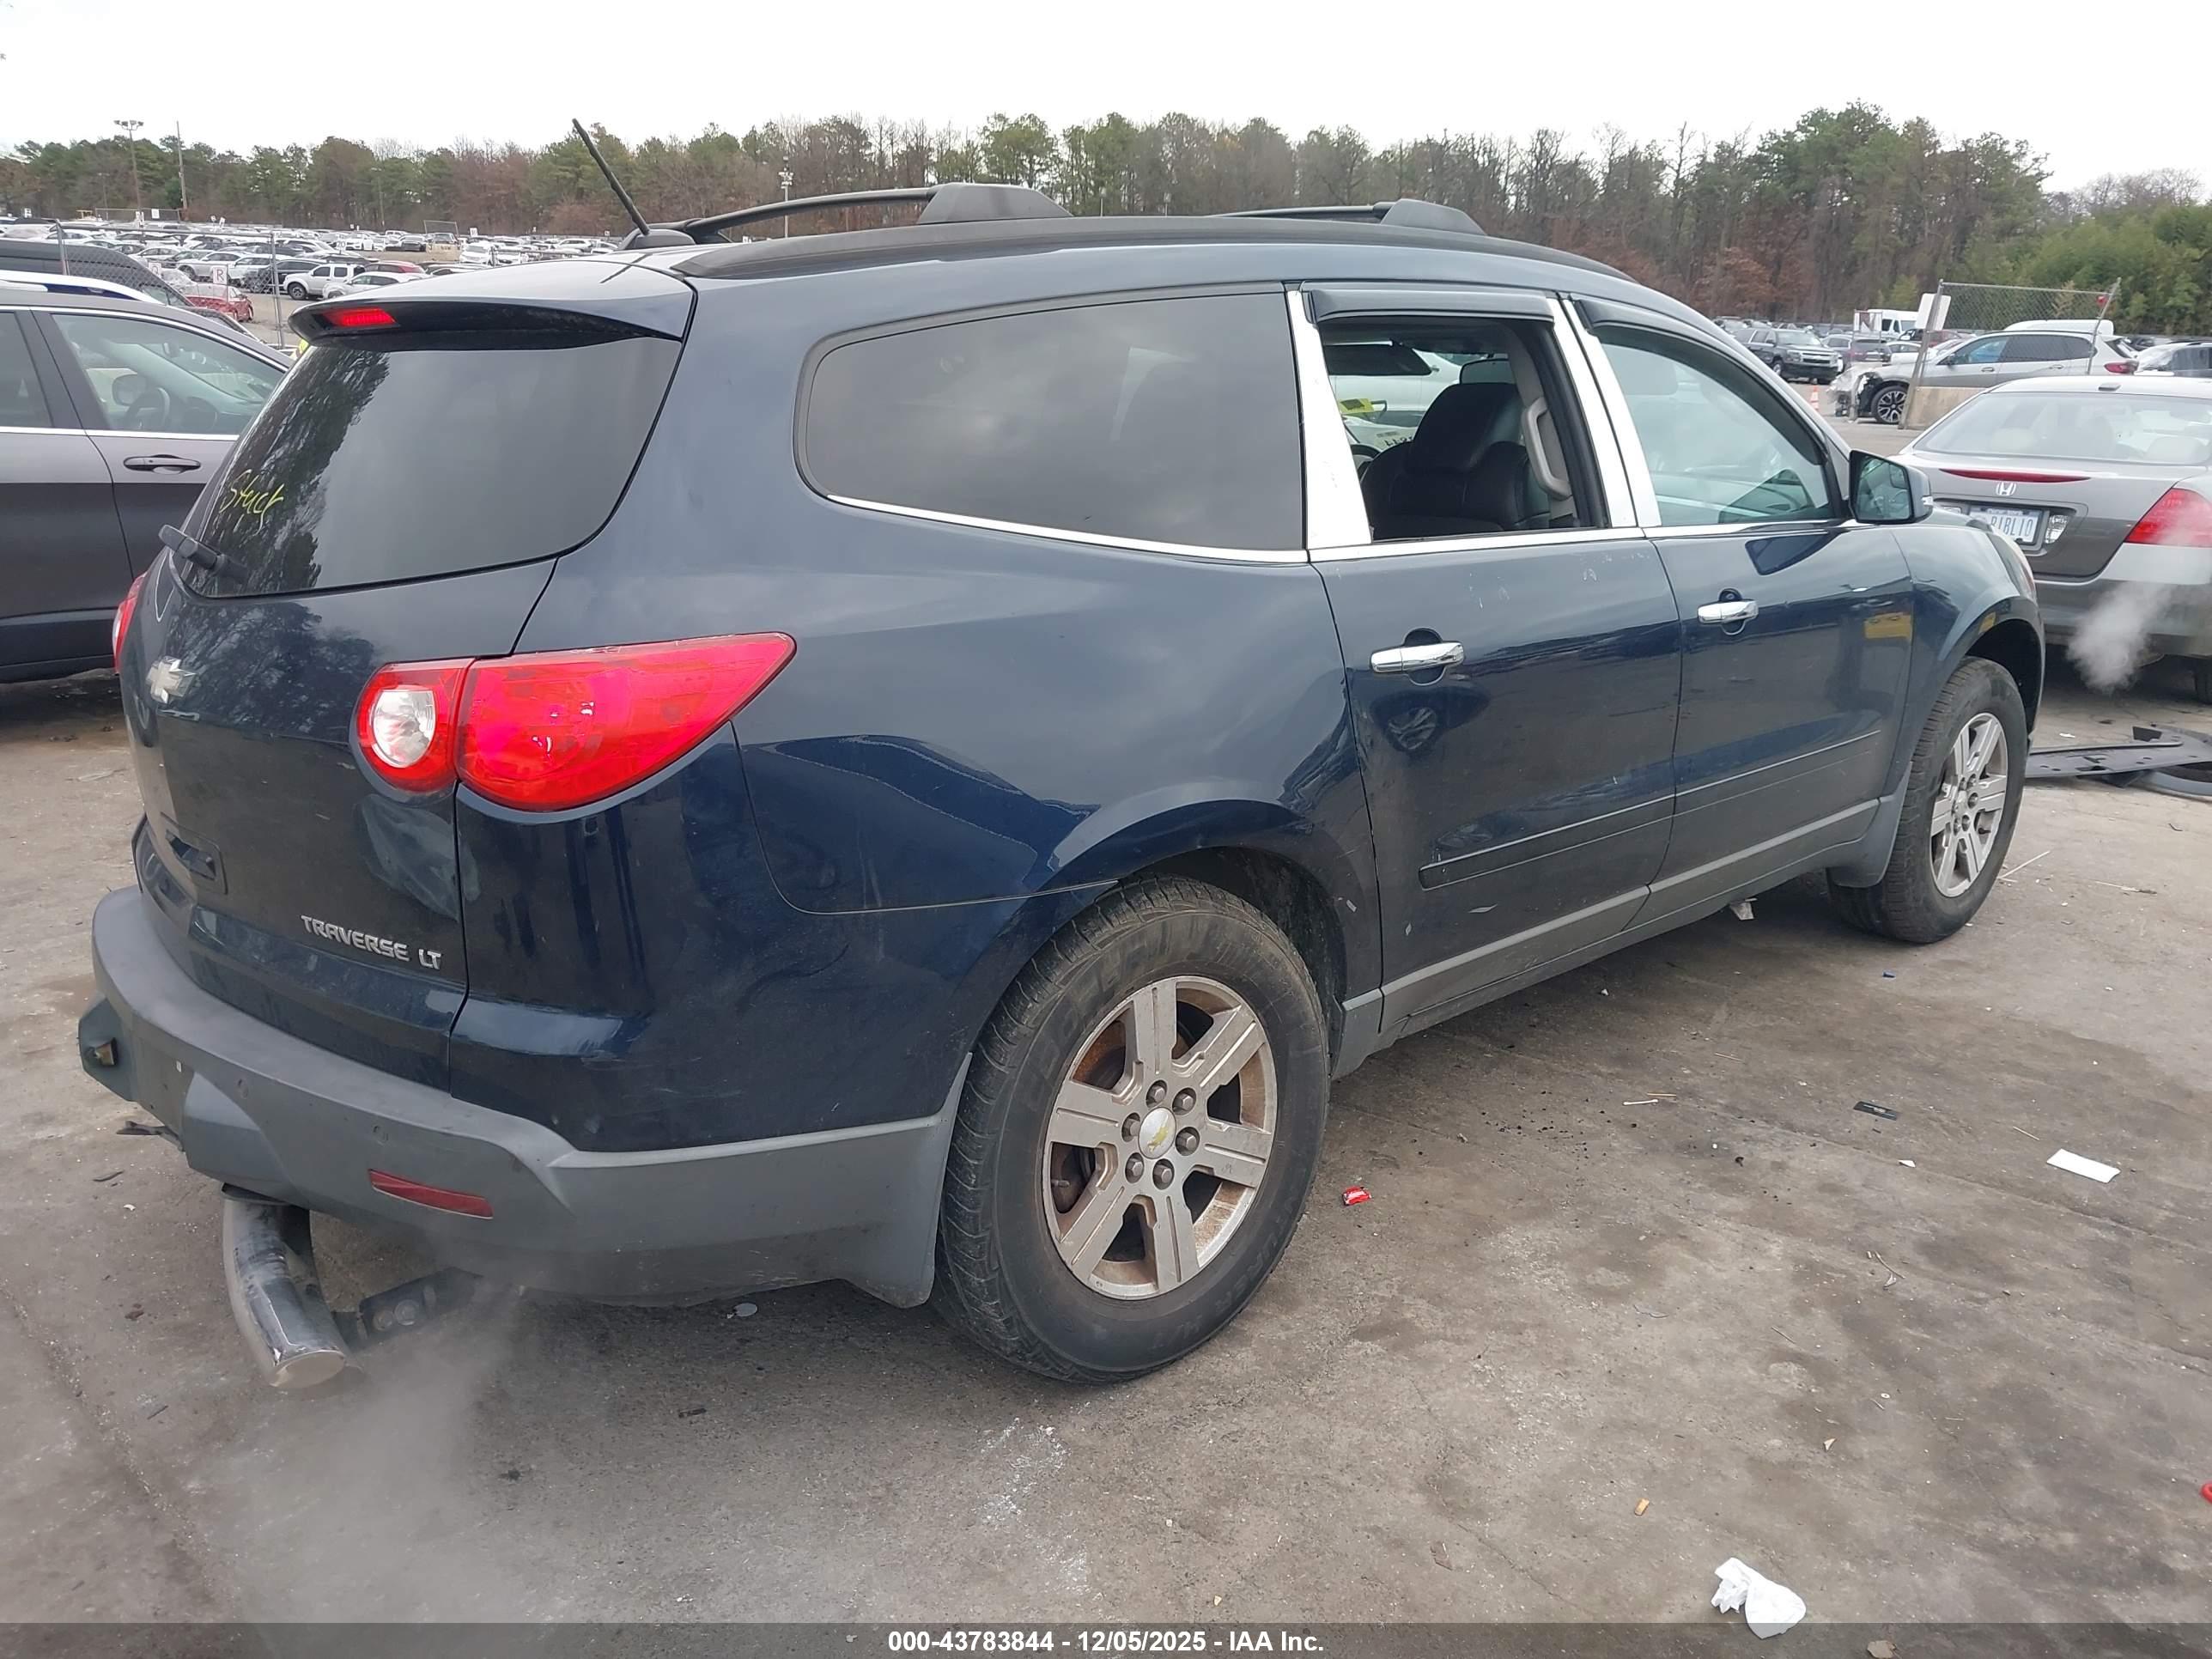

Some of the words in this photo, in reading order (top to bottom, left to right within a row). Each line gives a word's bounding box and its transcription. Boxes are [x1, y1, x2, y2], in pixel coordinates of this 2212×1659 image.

[216, 269, 224, 281] R
[301, 915, 410, 962] TRAVERSE
[418, 948, 442, 969] LT
